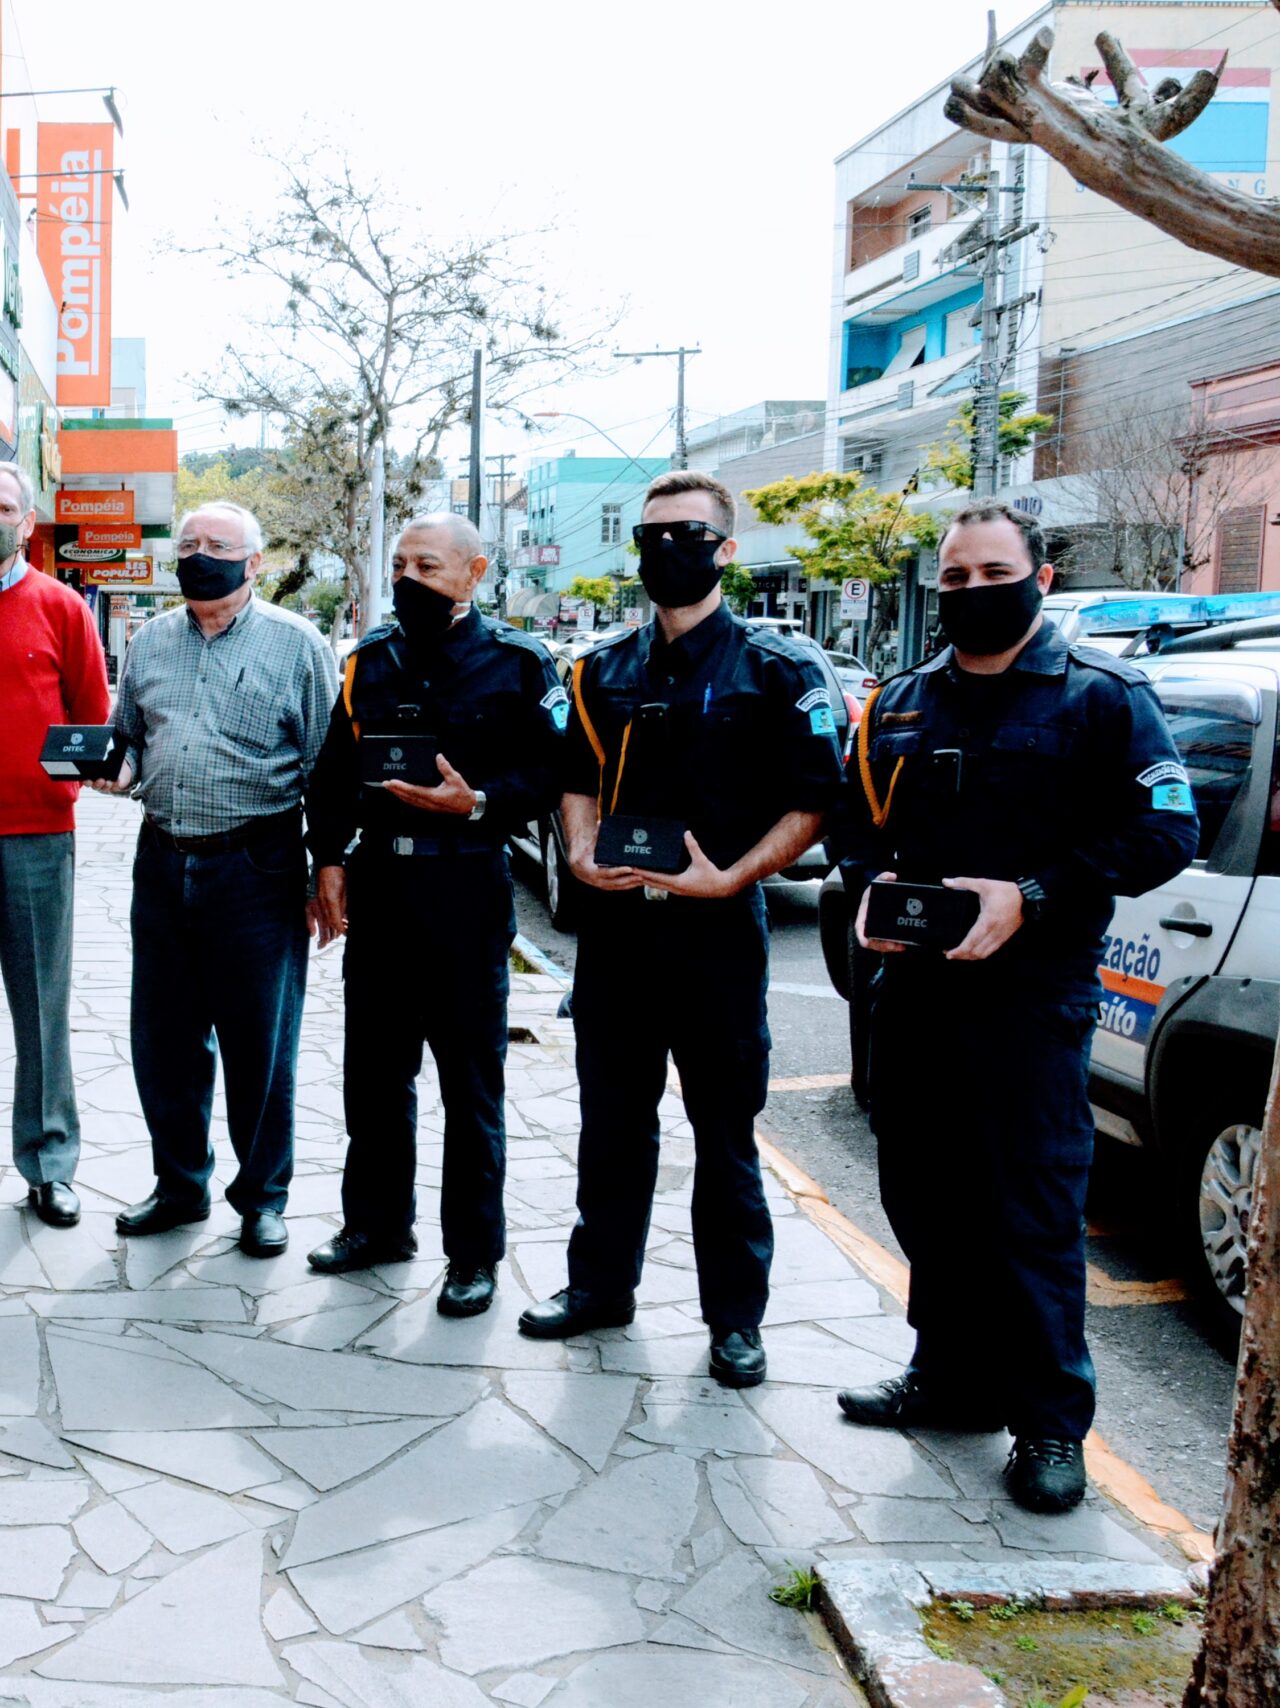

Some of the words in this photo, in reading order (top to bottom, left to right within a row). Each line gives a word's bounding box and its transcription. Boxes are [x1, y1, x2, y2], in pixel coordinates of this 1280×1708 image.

[49, 149, 101, 376] Pompéia
[60, 498, 125, 513] Pompéia
[92, 569, 149, 579] POPULAR
[851, 583, 861, 596] E
[62, 745, 86, 753] DITEC
[383, 762, 408, 771] DITEC
[624, 844, 652, 855] DITEC
[896, 916, 928, 928] DITEC
